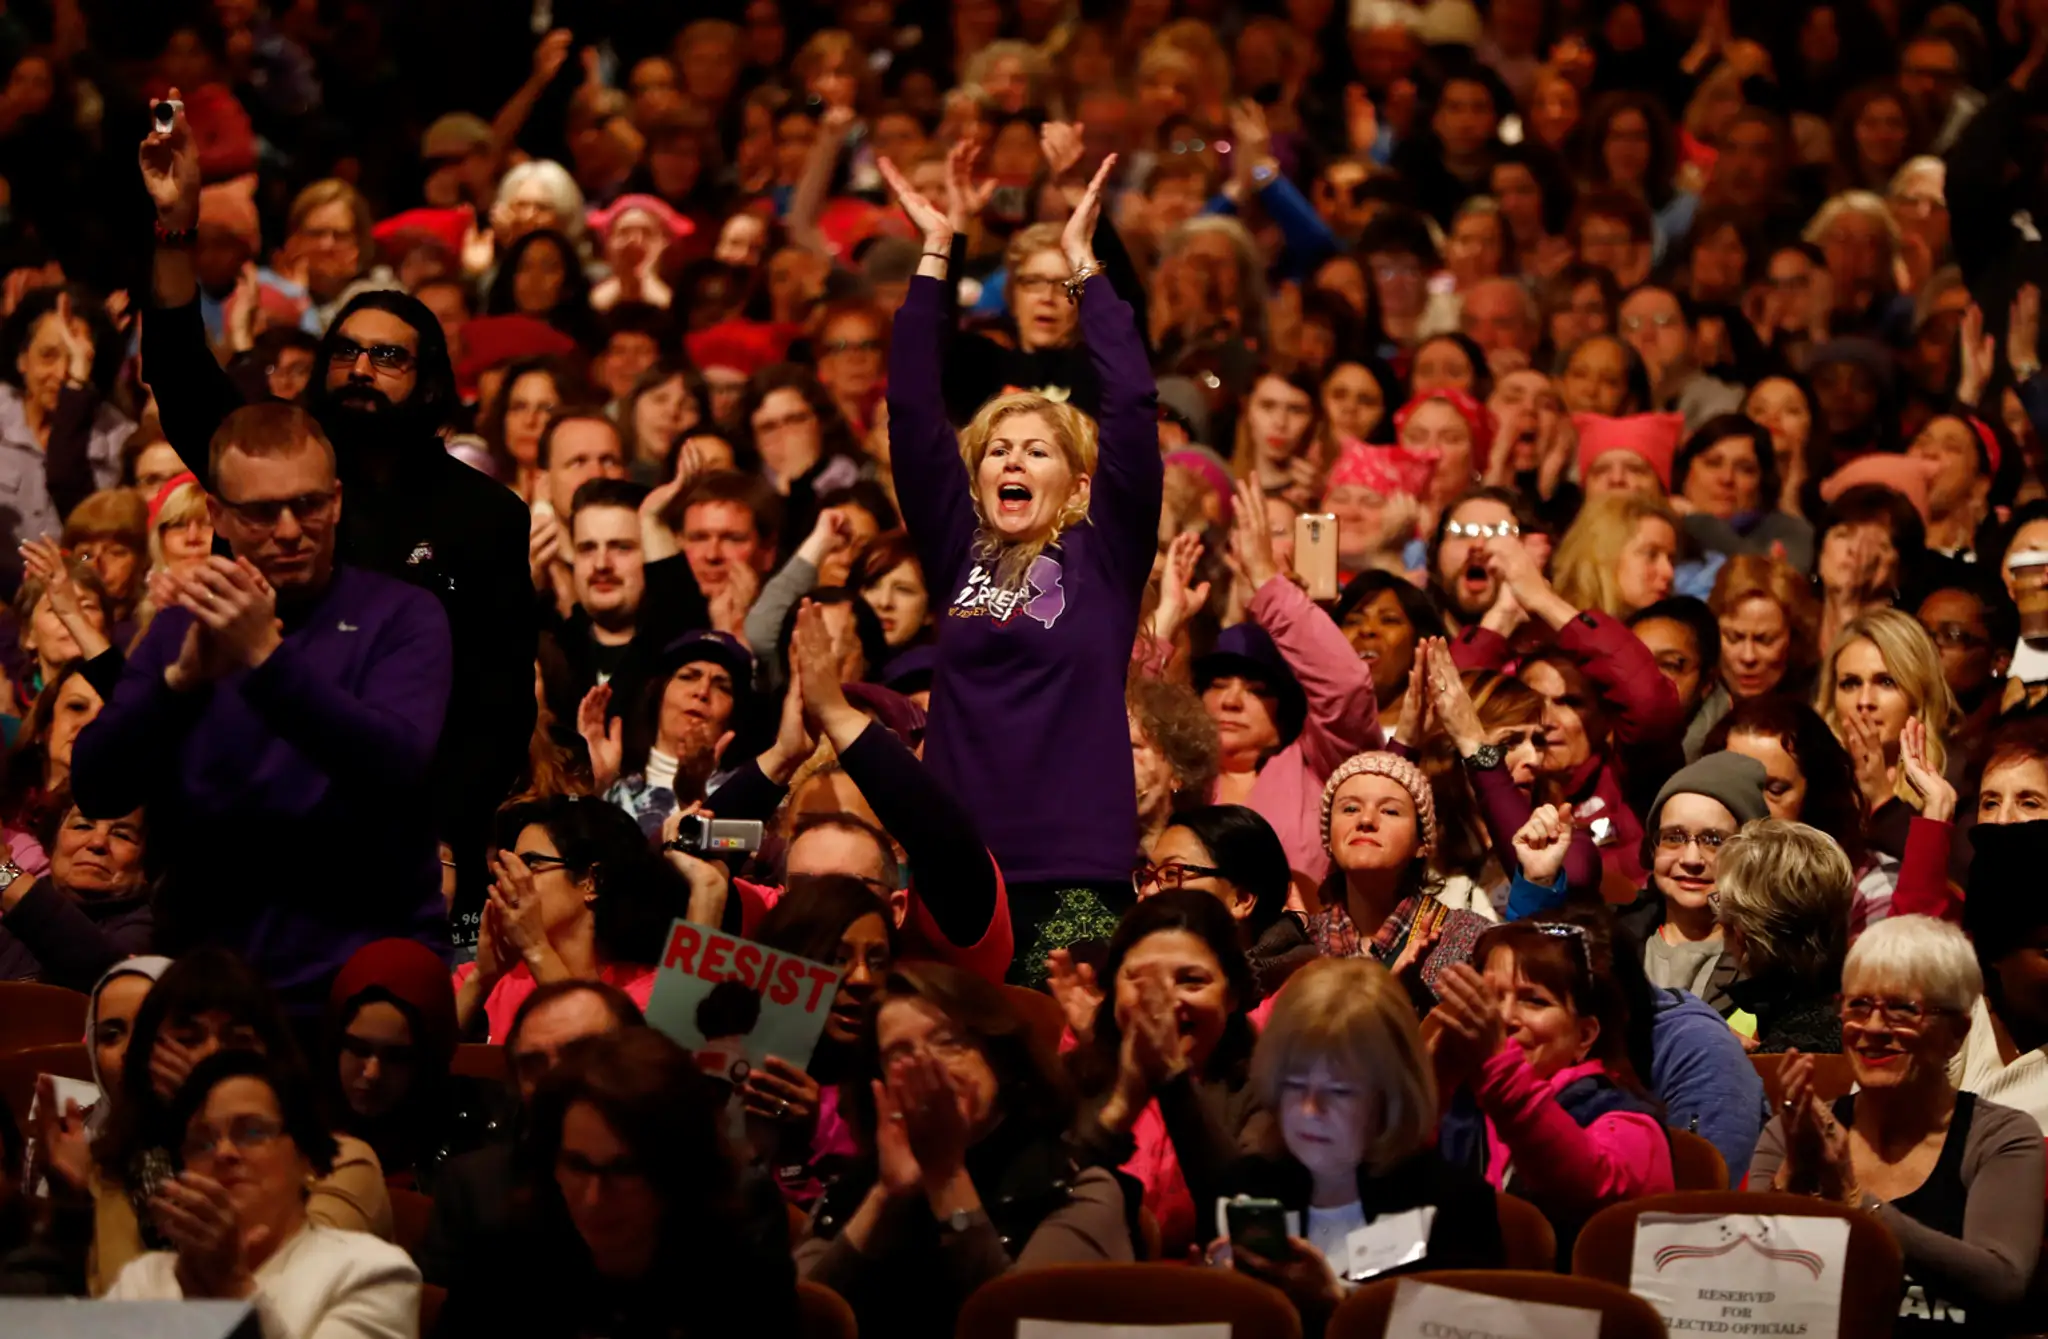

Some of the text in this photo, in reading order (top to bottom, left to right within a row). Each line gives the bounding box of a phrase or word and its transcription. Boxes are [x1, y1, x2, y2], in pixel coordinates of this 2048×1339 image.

[665, 925, 837, 1013] RESIST
[1698, 1289, 1775, 1303] RESERVED
[1721, 1306, 1752, 1318] FOR
[1732, 1322, 1807, 1334] OFFICIALS
